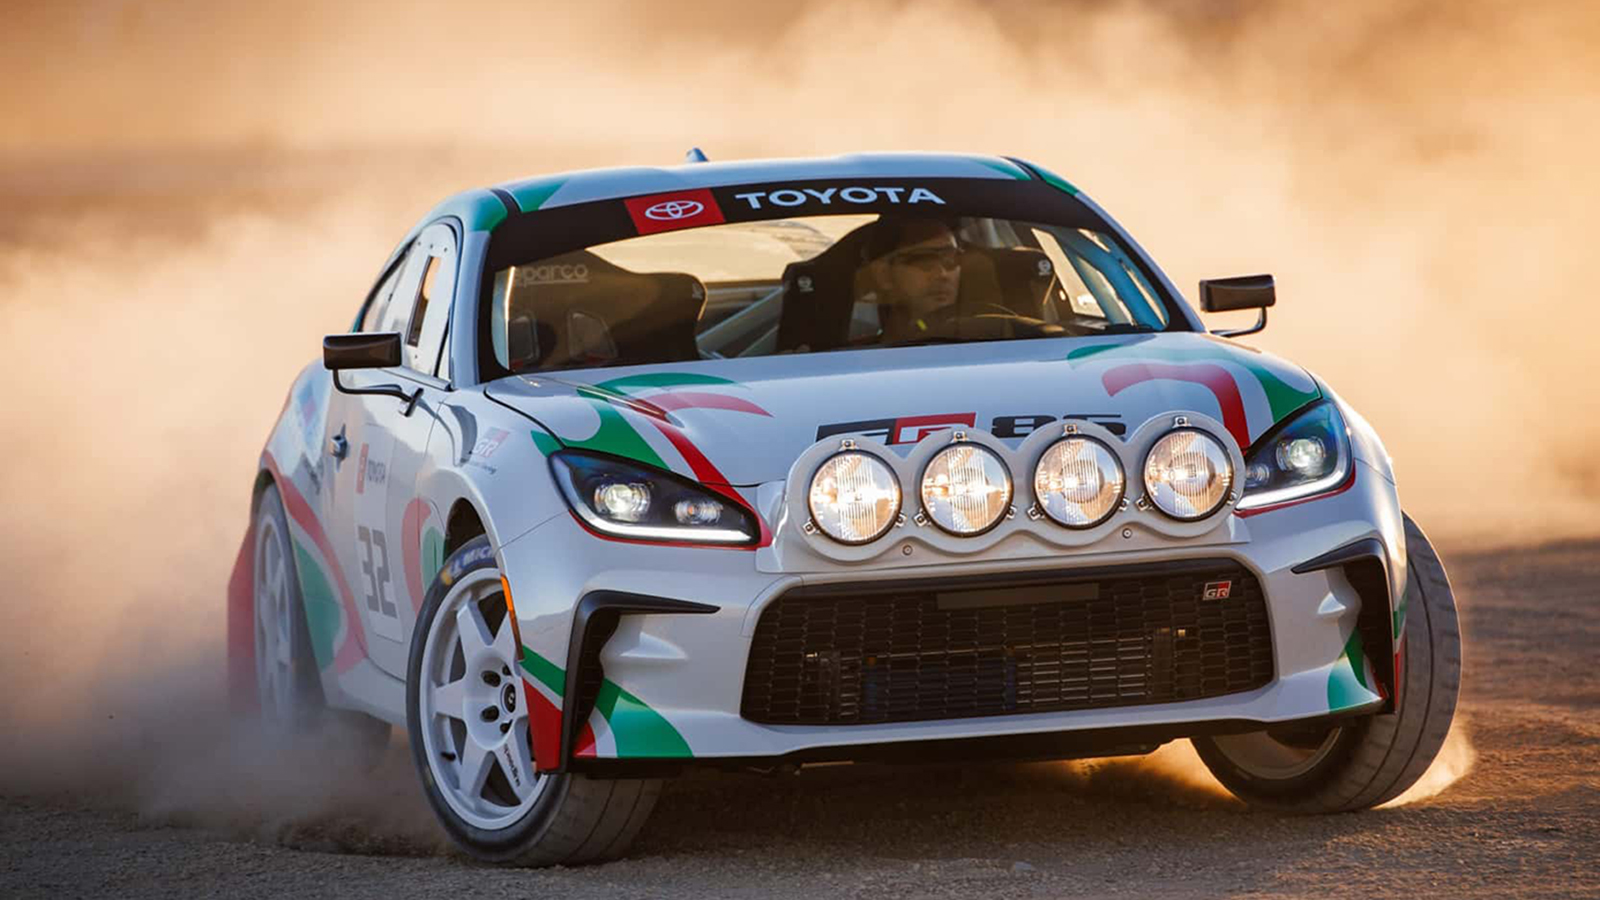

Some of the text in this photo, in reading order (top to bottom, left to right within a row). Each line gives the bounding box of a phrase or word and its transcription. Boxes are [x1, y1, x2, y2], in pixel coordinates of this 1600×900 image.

[735, 187, 946, 209] TOYOTA
[357, 525, 398, 619] 32
[1204, 584, 1230, 599] GR
